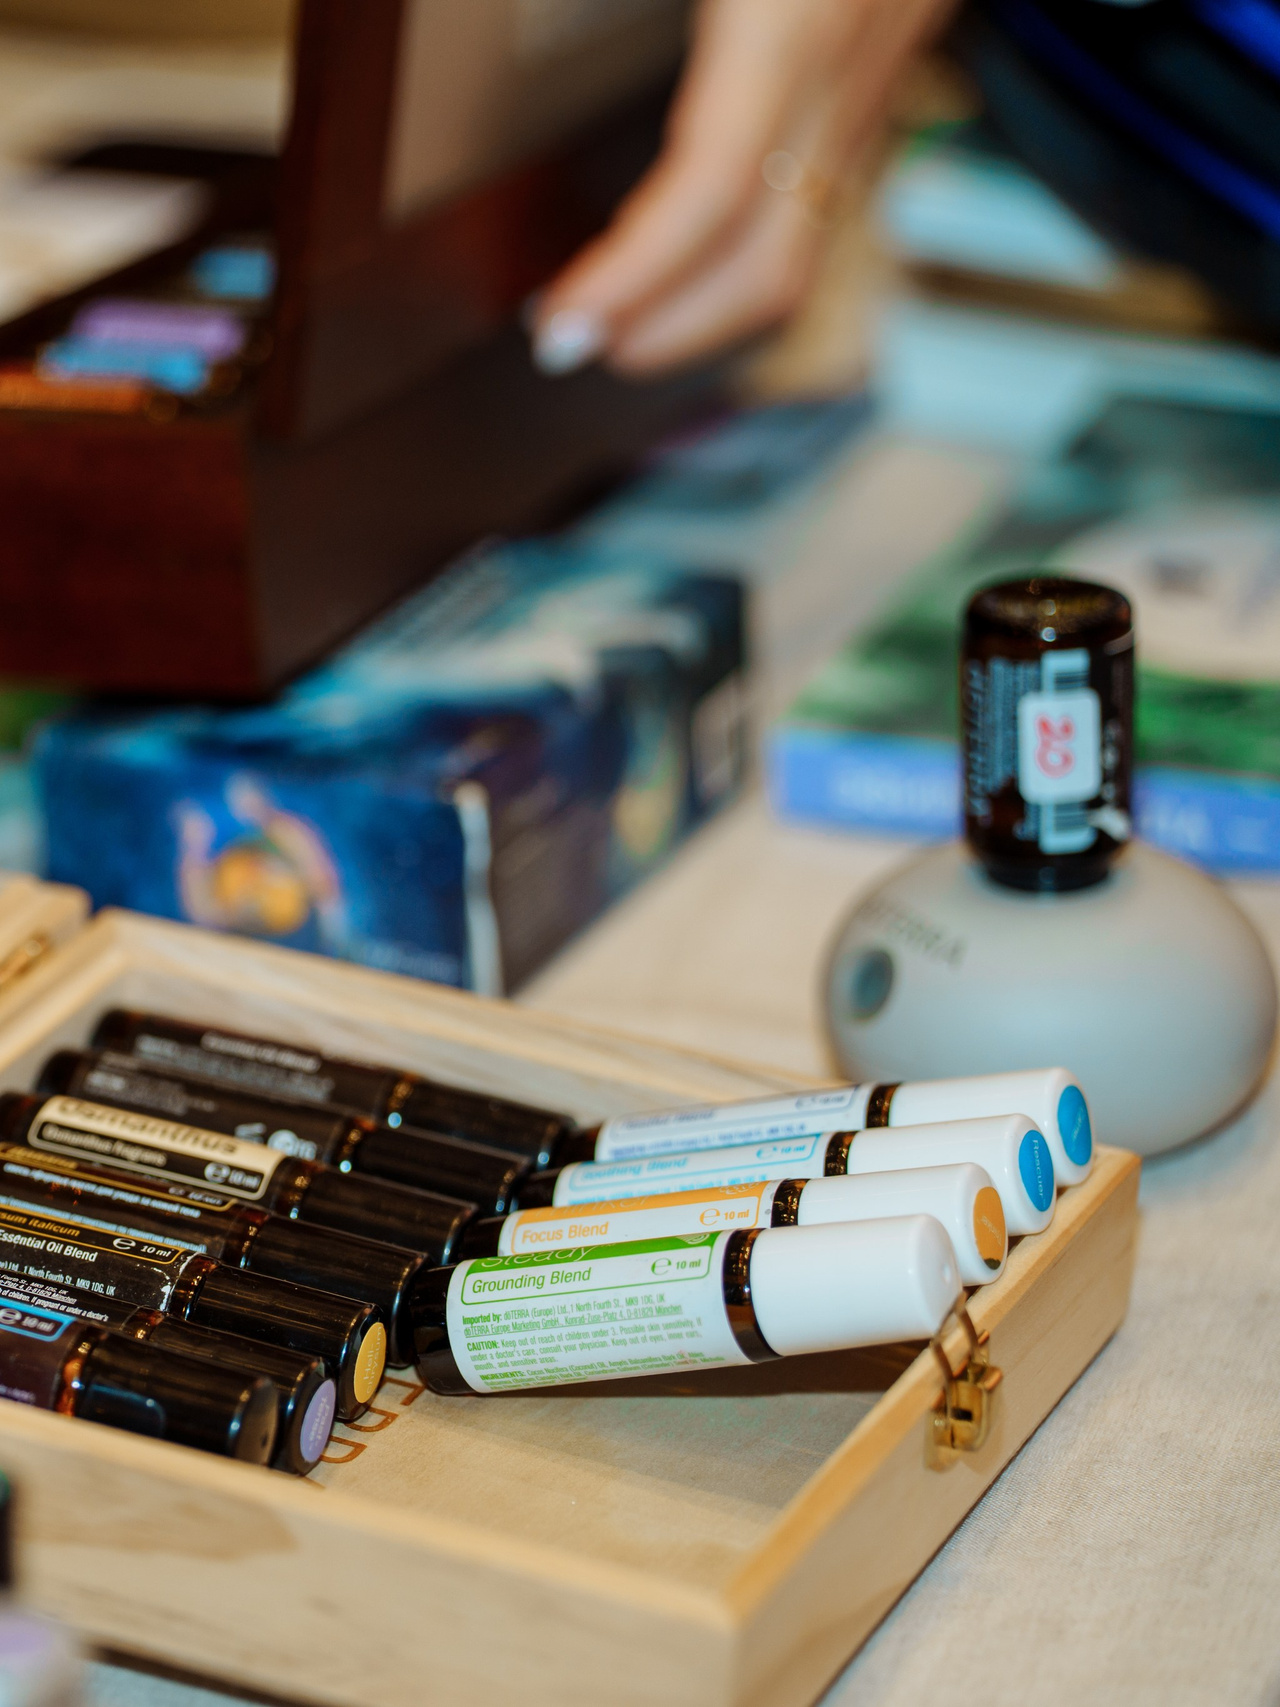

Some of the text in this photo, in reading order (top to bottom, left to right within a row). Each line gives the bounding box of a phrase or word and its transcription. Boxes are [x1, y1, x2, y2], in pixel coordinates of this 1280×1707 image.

[28, 1217, 81, 1238] italicum
[140, 1244, 156, 1255] 10
[157, 1246, 172, 1258] ml
[521, 1209, 750, 1244] Focus Blend 10 ml
[46, 1240, 63, 1255] Oil
[63, 1244, 99, 1263] Blend
[46, 1271, 63, 1282] Fourth
[76, 1278, 90, 1288] MK9
[106, 1285, 115, 1295] UK
[471, 1258, 702, 1294] Grounding Blend 10 ml
[8, 1290, 30, 1301] children.
[35, 1298, 59, 1310] pregnant
[66, 1305, 81, 1315] under
[21, 1315, 37, 1329] 10
[37, 1319, 55, 1333] ml
[467, 1340, 498, 1351] CAUTION:
